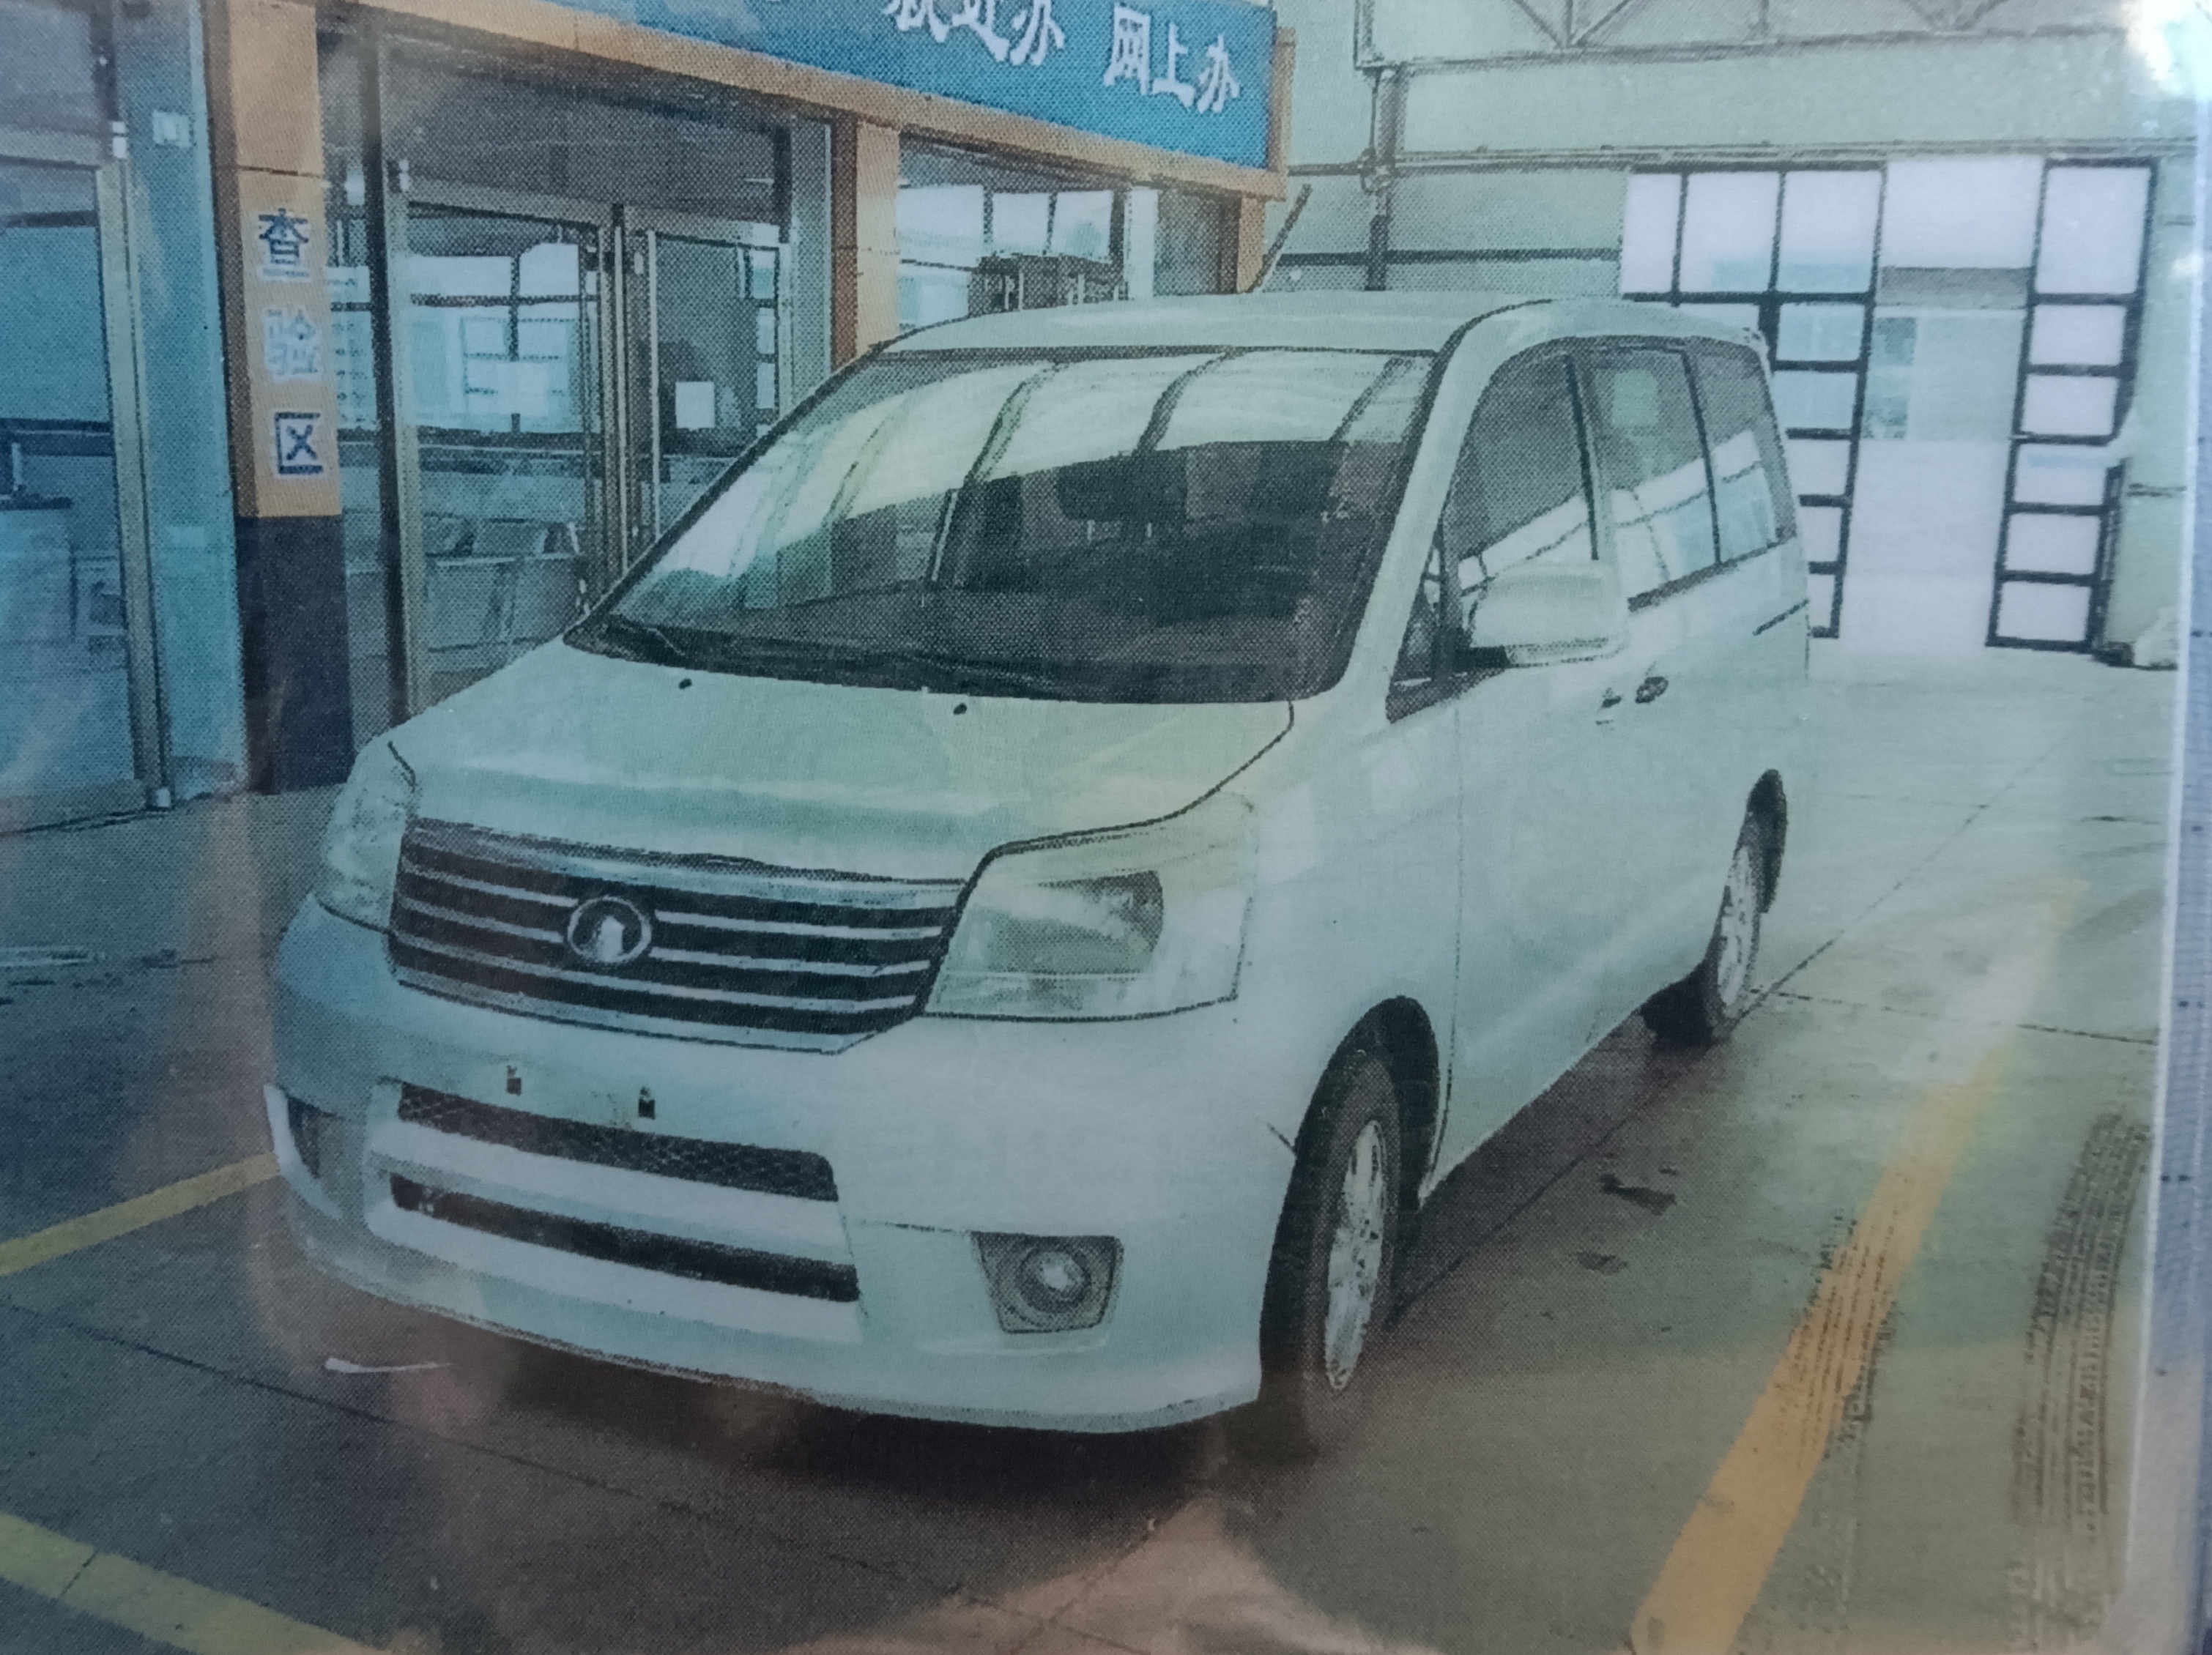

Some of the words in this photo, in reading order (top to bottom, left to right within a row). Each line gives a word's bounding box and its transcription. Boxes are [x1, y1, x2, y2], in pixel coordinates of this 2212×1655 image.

[1103, 4, 1240, 114] 网上办
[258, 208, 324, 476] 查验区
